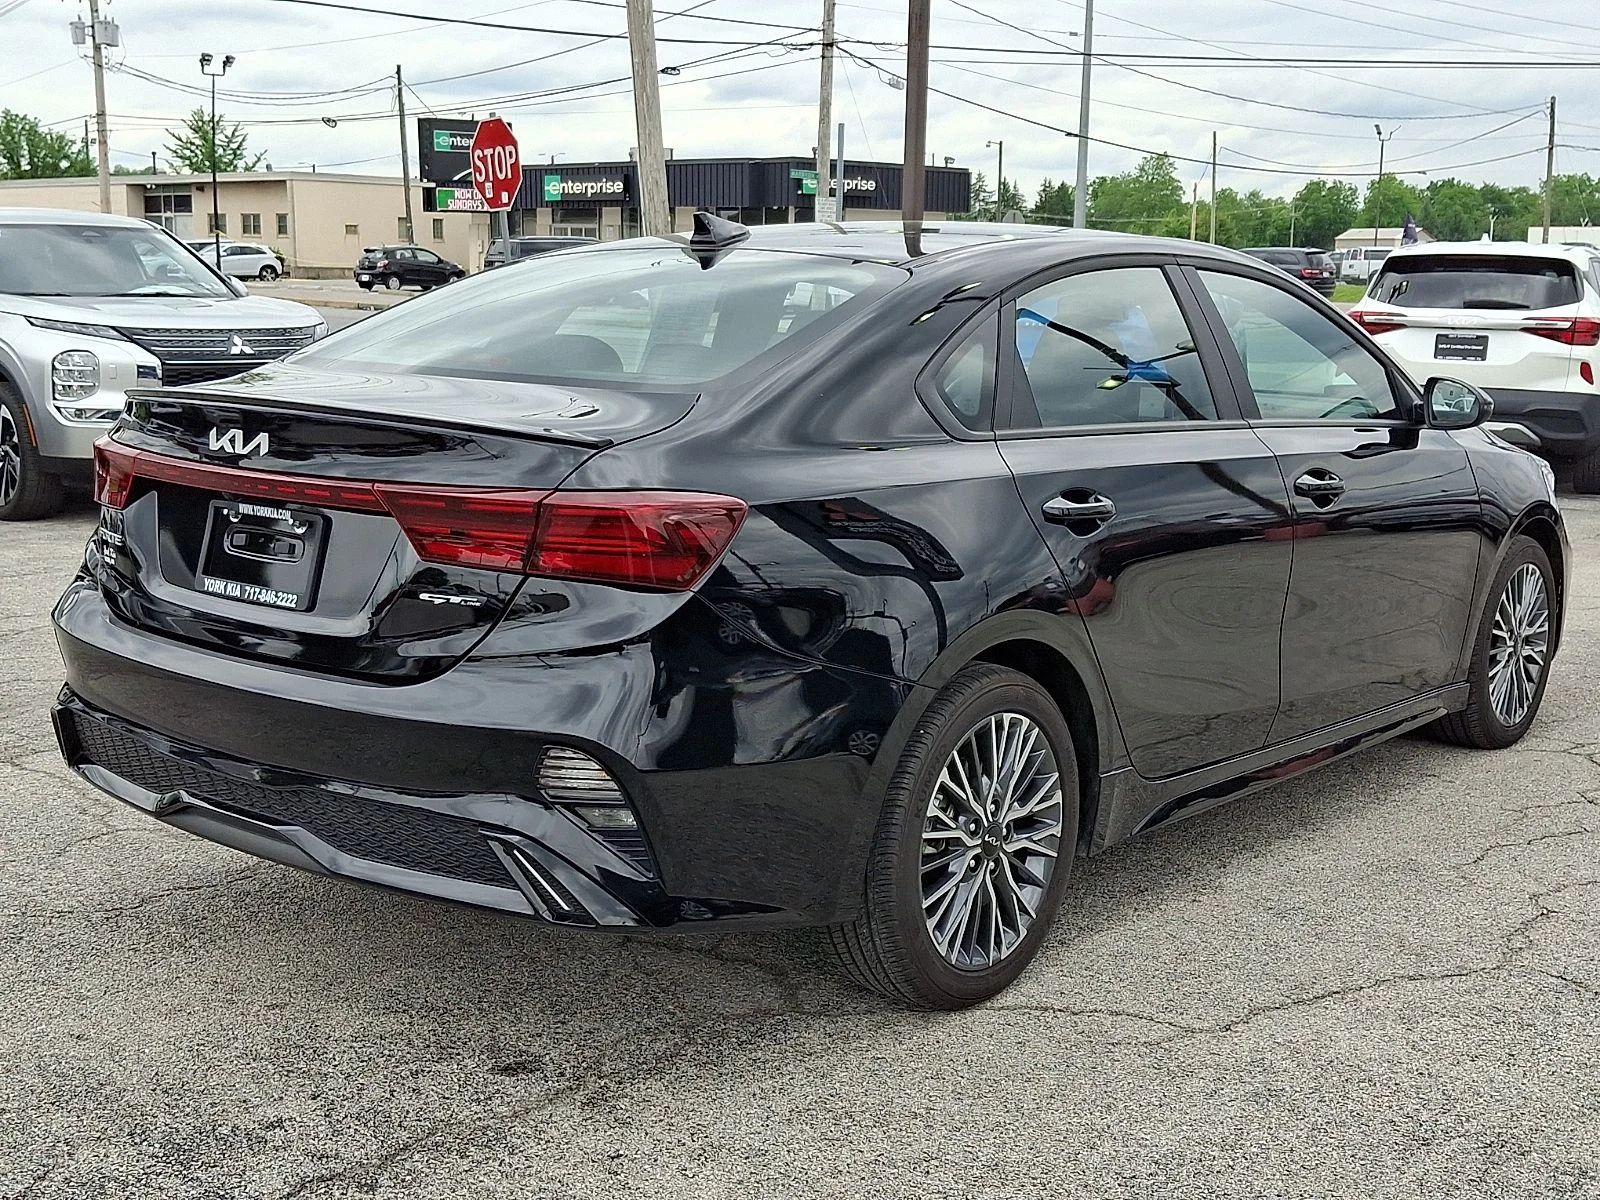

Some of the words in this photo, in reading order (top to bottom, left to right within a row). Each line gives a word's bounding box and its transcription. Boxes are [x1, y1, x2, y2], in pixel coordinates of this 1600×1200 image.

[474, 145, 517, 183] STOP
[454, 189, 472, 200] NOW
[548, 177, 624, 197] enterprise
[447, 199, 482, 210] SUNDAYS
[239, 503, 292, 520] WWW.YORKKIA.COM
[204, 578, 226, 594] YORK
[225, 583, 241, 597] KIA
[244, 586, 298, 608] 717-846-2222
